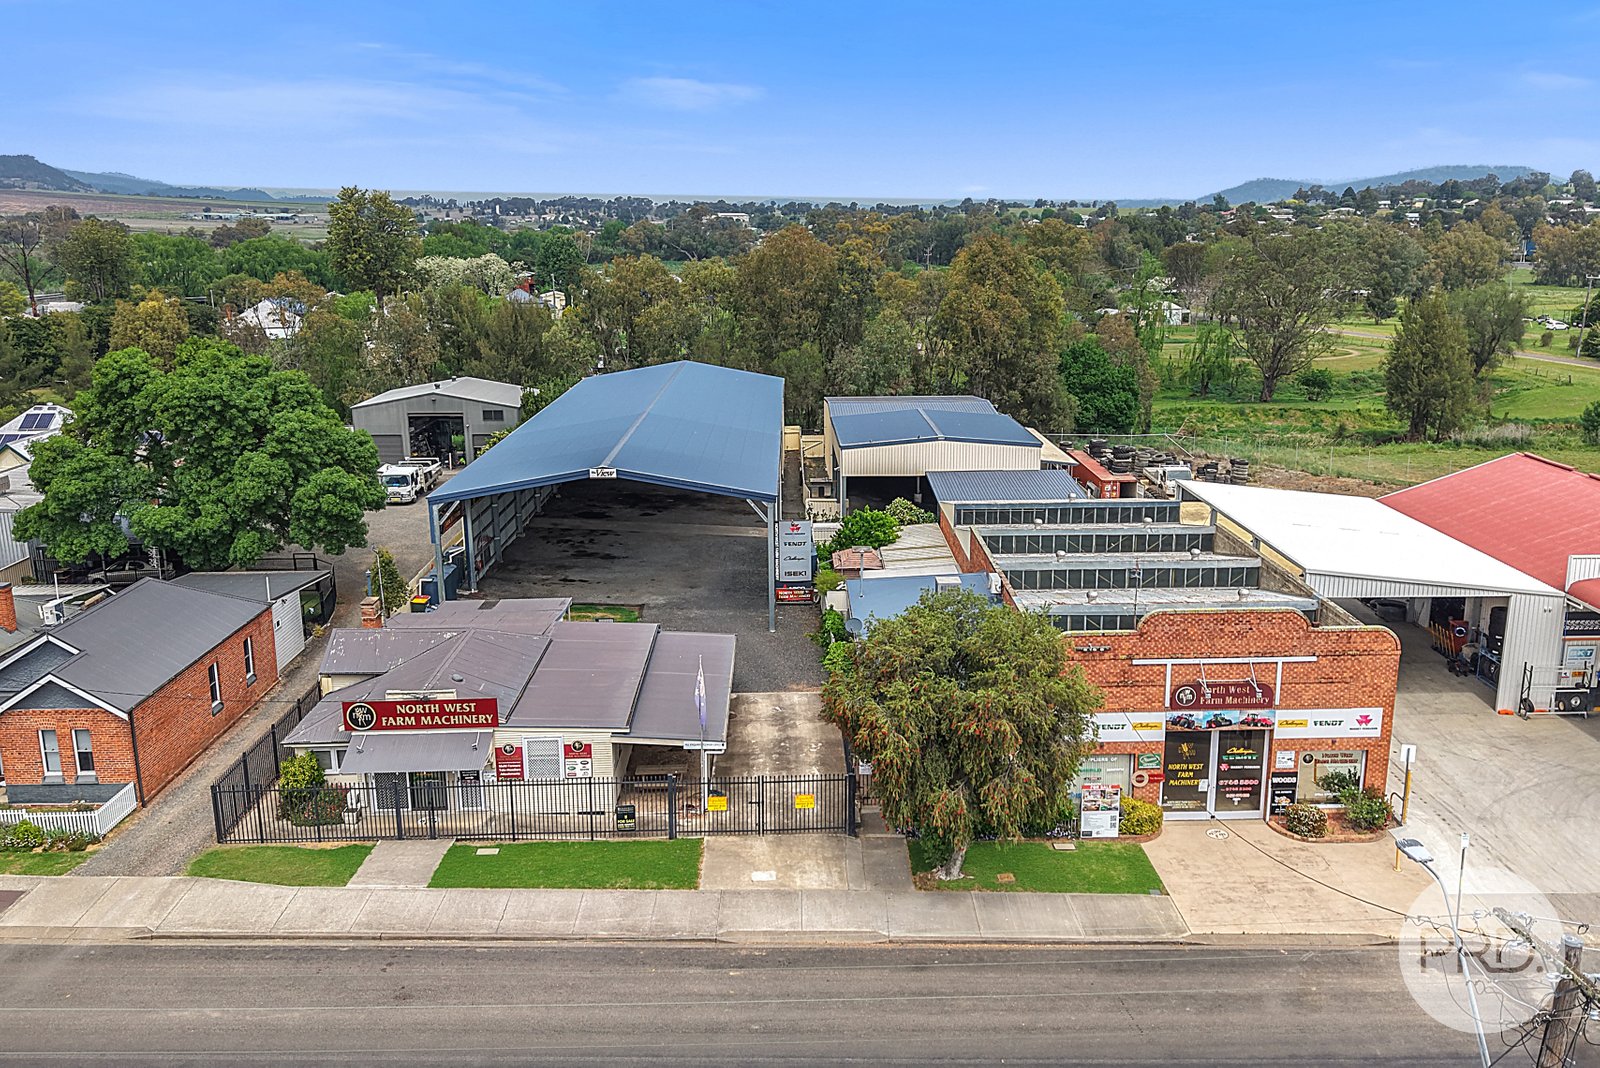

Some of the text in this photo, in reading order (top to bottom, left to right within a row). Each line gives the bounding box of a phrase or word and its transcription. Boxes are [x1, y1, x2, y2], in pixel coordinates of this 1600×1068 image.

[596, 469, 615, 477] View
[1228, 685, 1250, 694] West
[1200, 696, 1223, 705] Farm
[396, 702, 476, 715] NORTH WEST
[381, 714, 494, 727] FARM MACHINERY
